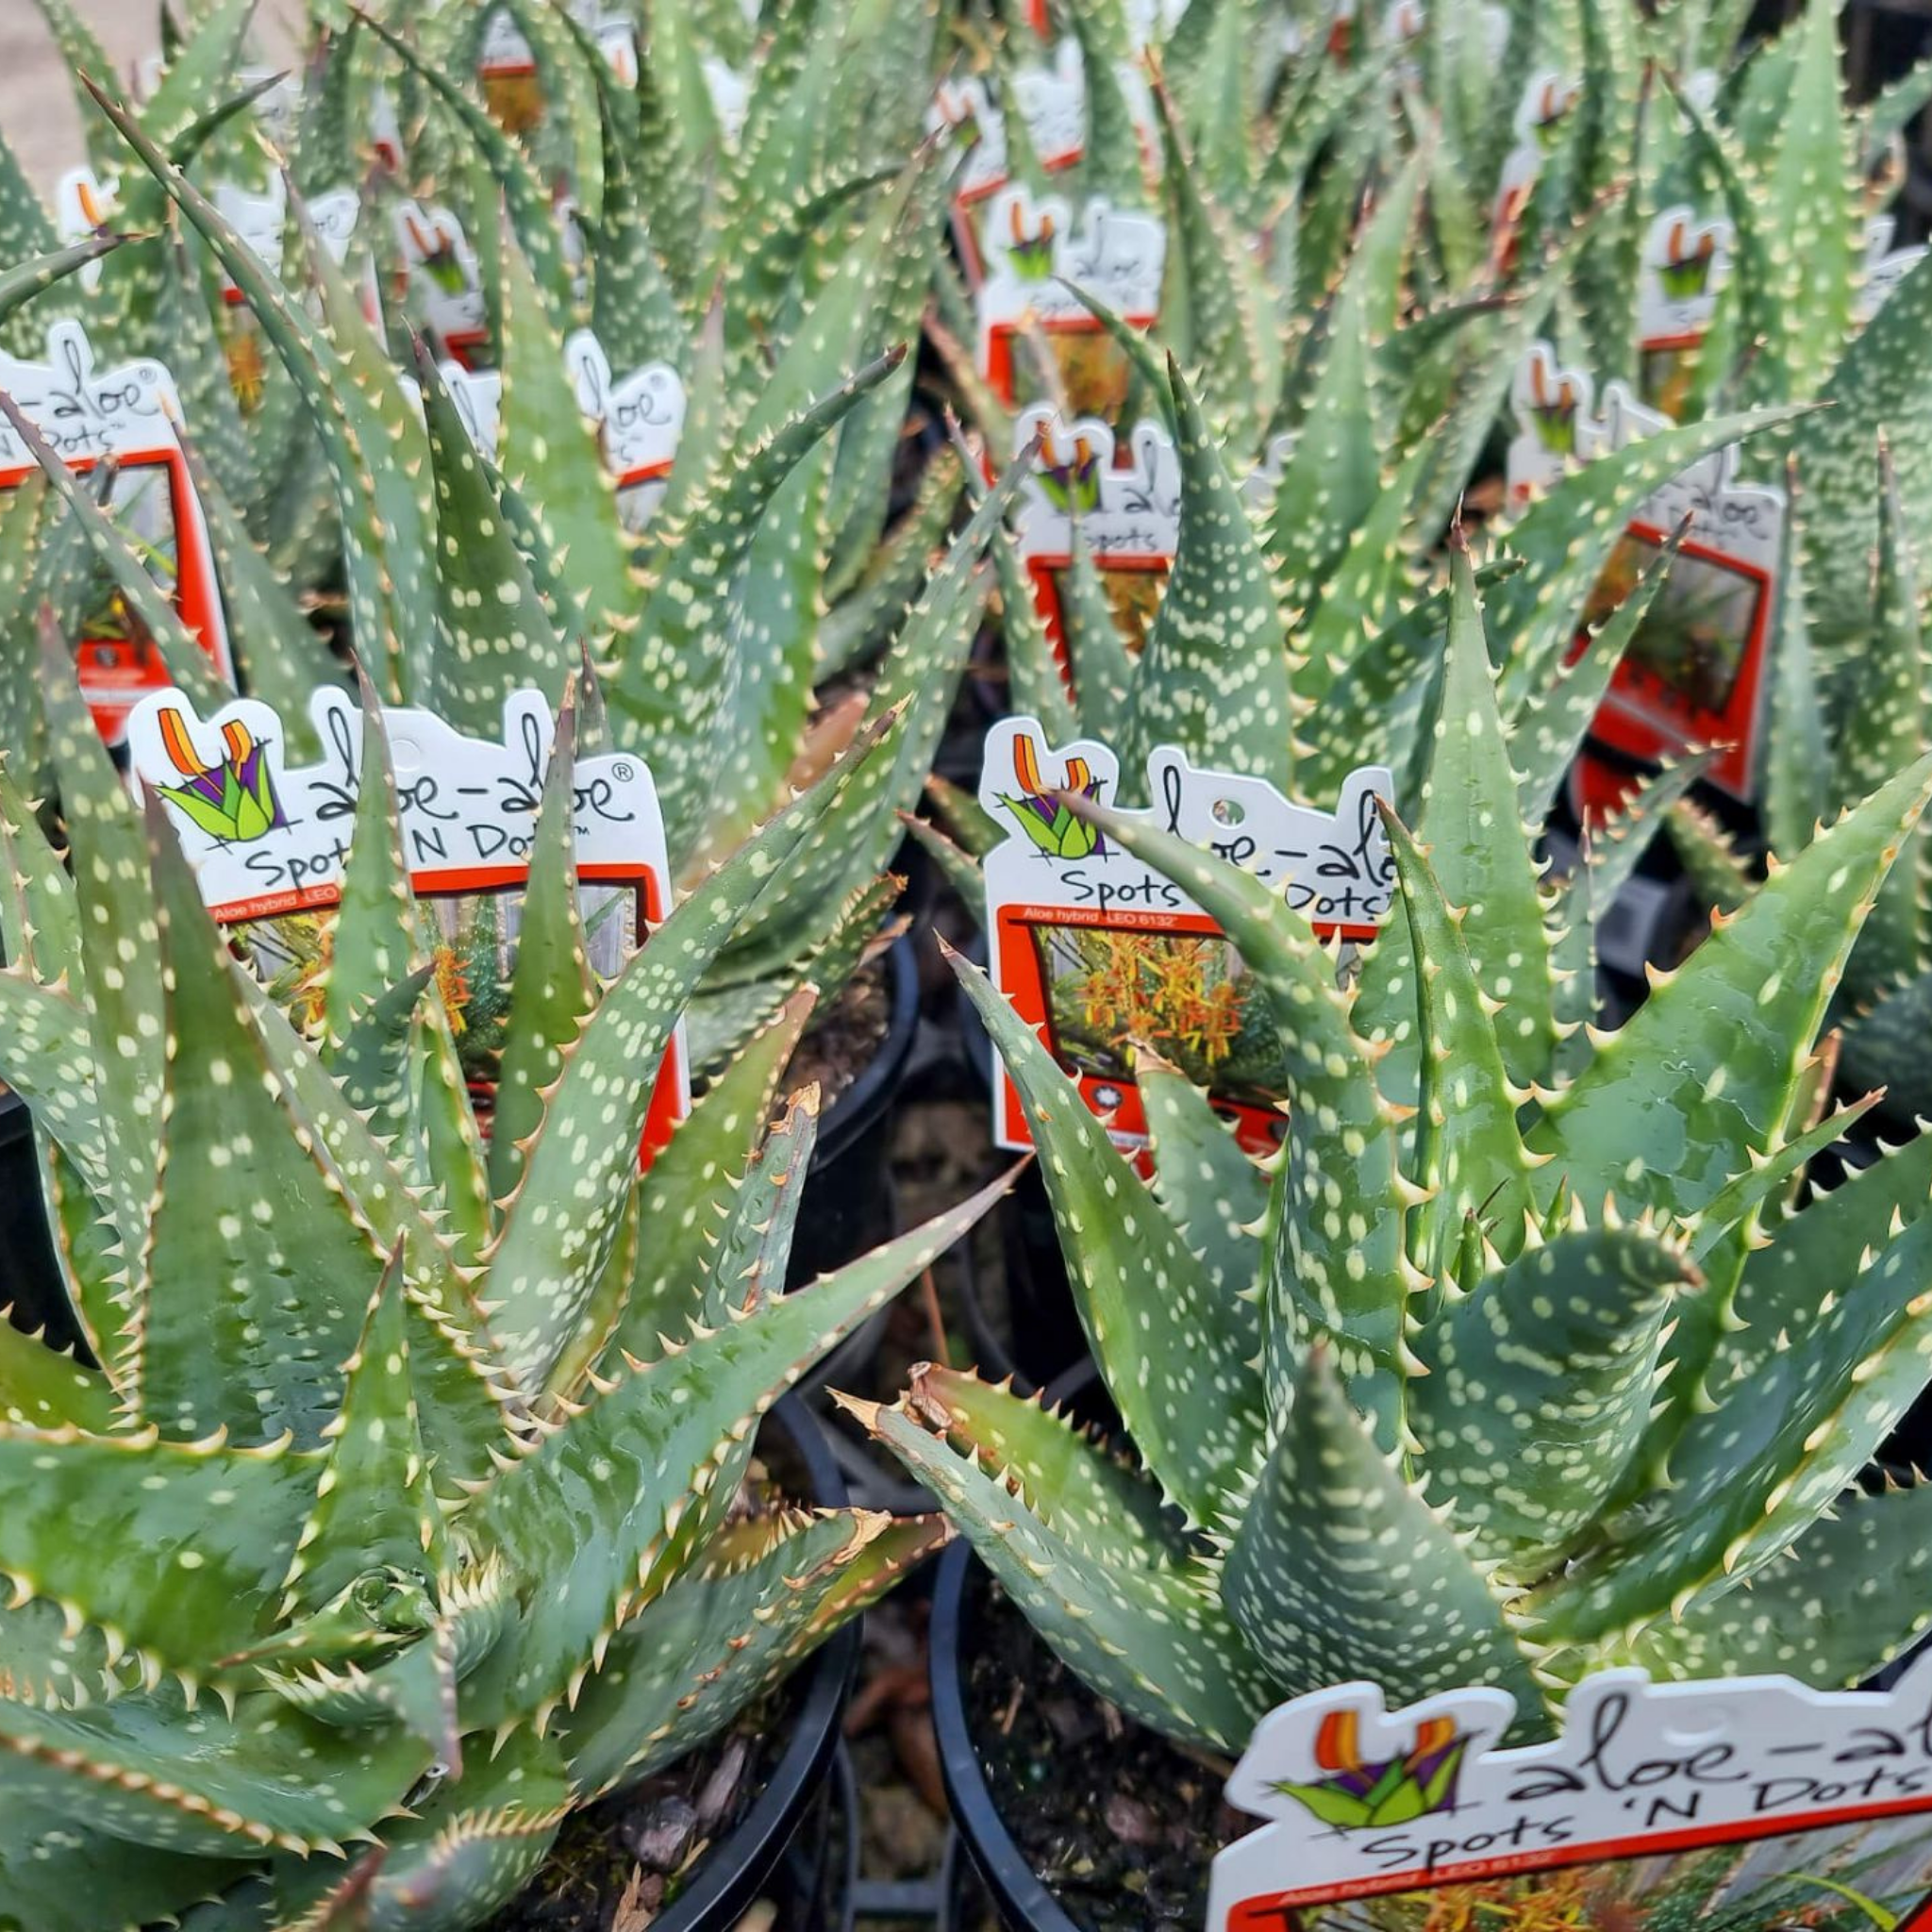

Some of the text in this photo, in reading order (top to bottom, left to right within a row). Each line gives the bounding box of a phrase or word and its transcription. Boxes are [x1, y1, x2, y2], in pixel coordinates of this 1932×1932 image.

[245, 837, 351, 898] Spot
[1060, 870, 1182, 916] Spots
[1024, 907, 1054, 920] Aloe
[1057, 908, 1099, 924] hybrid
[1360, 1766, 1931, 1874] Spots 'N Dots
